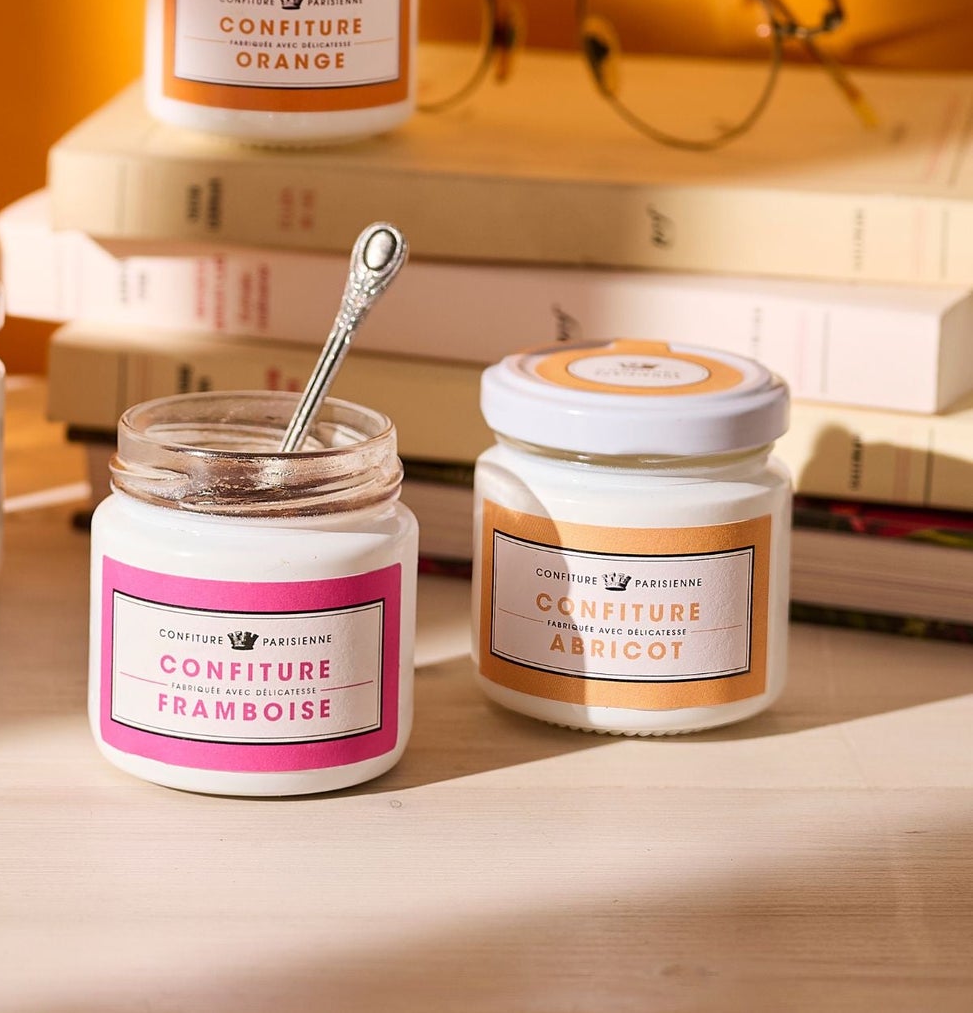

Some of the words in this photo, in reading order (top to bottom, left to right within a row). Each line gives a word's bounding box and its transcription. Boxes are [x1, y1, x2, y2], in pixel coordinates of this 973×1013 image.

[220, 17, 362, 36] CONFITURE
[236, 52, 345, 69] ORANGE
[536, 568, 597, 585] CONFITURE
[635, 578, 702, 588] PARISIENNE
[536, 593, 700, 622] CONFITURE
[159, 628, 223, 644] CONFITURE
[263, 634, 332, 646] PARISIENNE
[547, 620, 594, 633] FABRIQUÉE
[627, 628, 687, 636] DÉLICATESSE
[550, 634, 683, 660] ABRICOT
[160, 655, 330, 681] CONFITURE
[172, 682, 220, 694] FABRIQUÉE
[256, 687, 316, 696] DÉLICATESSE
[158, 693, 330, 721] FRAMBOISE
